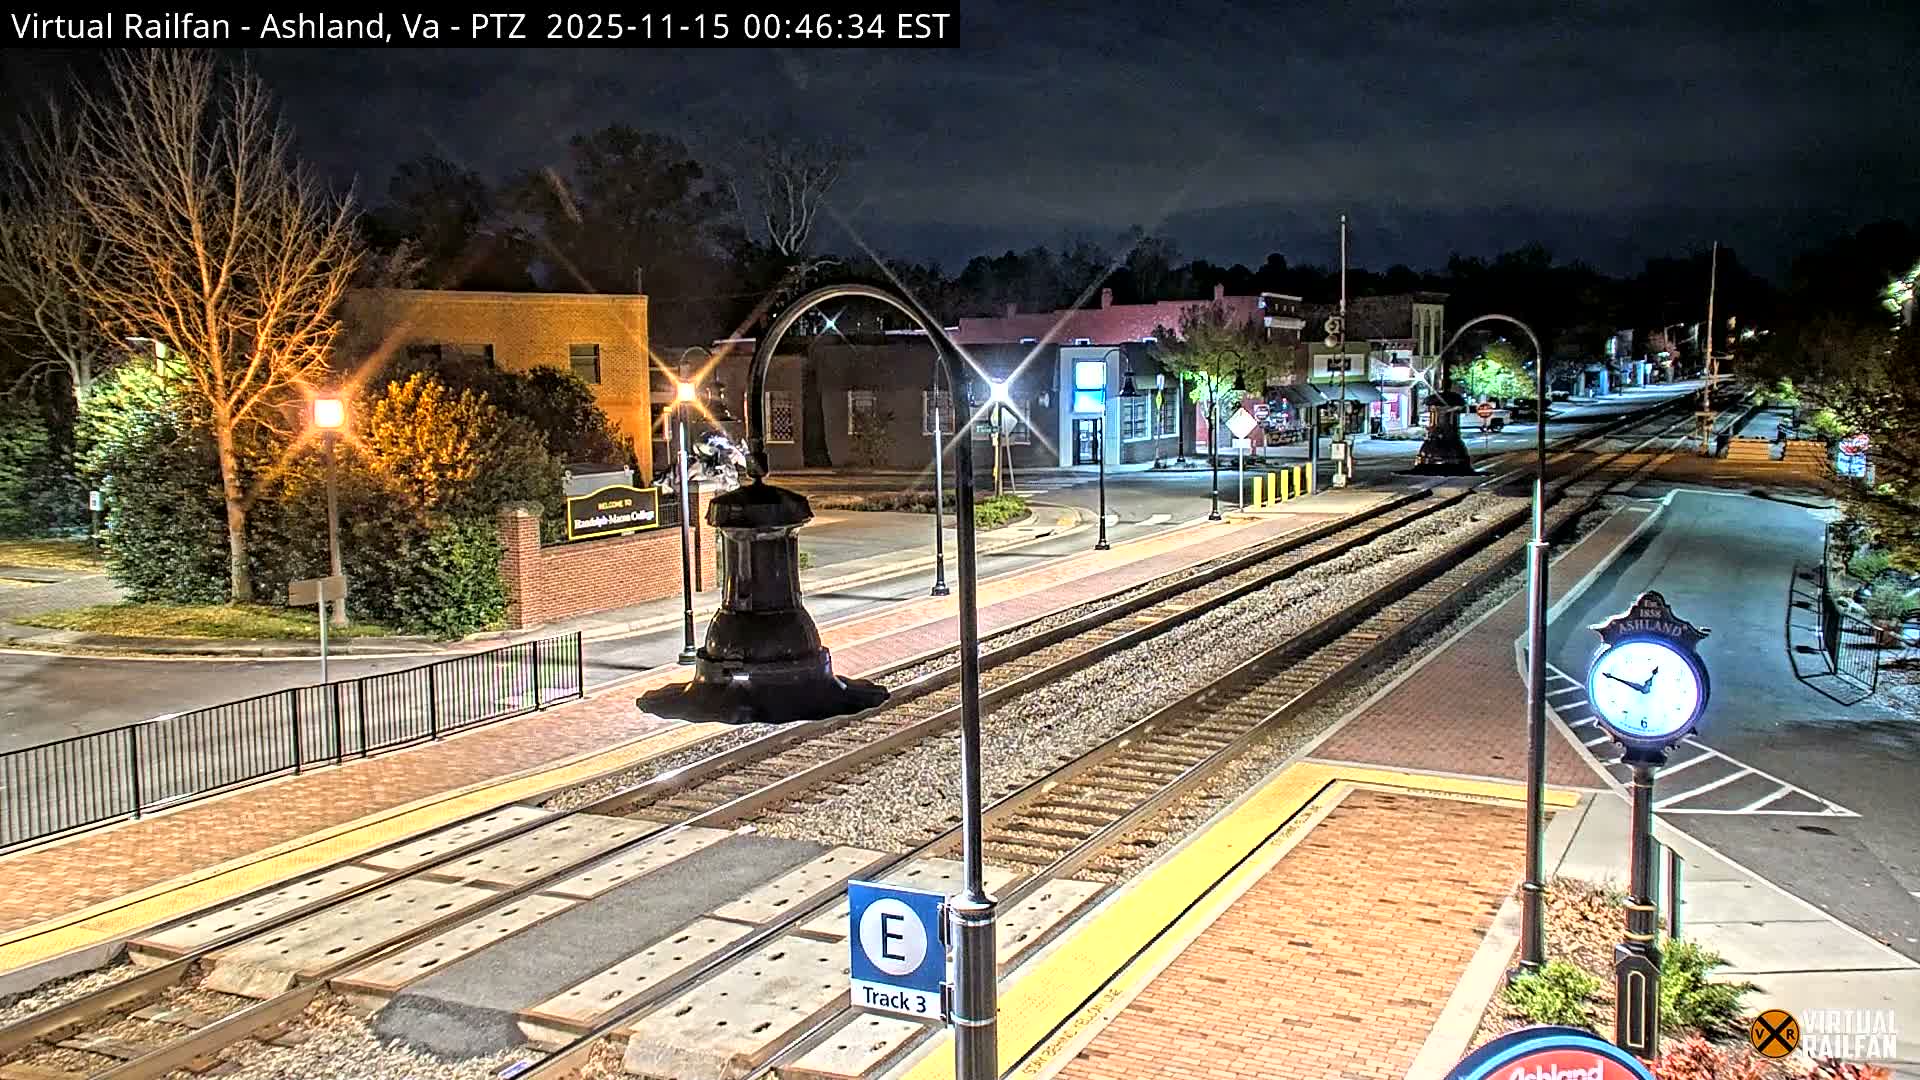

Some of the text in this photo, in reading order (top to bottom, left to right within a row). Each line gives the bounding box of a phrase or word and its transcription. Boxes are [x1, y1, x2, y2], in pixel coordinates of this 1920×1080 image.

[1618, 619, 1683, 637] ASHLAND
[1640, 719, 1648, 729] 6
[880, 912, 906, 962] E
[862, 986, 928, 1013] Track 3
